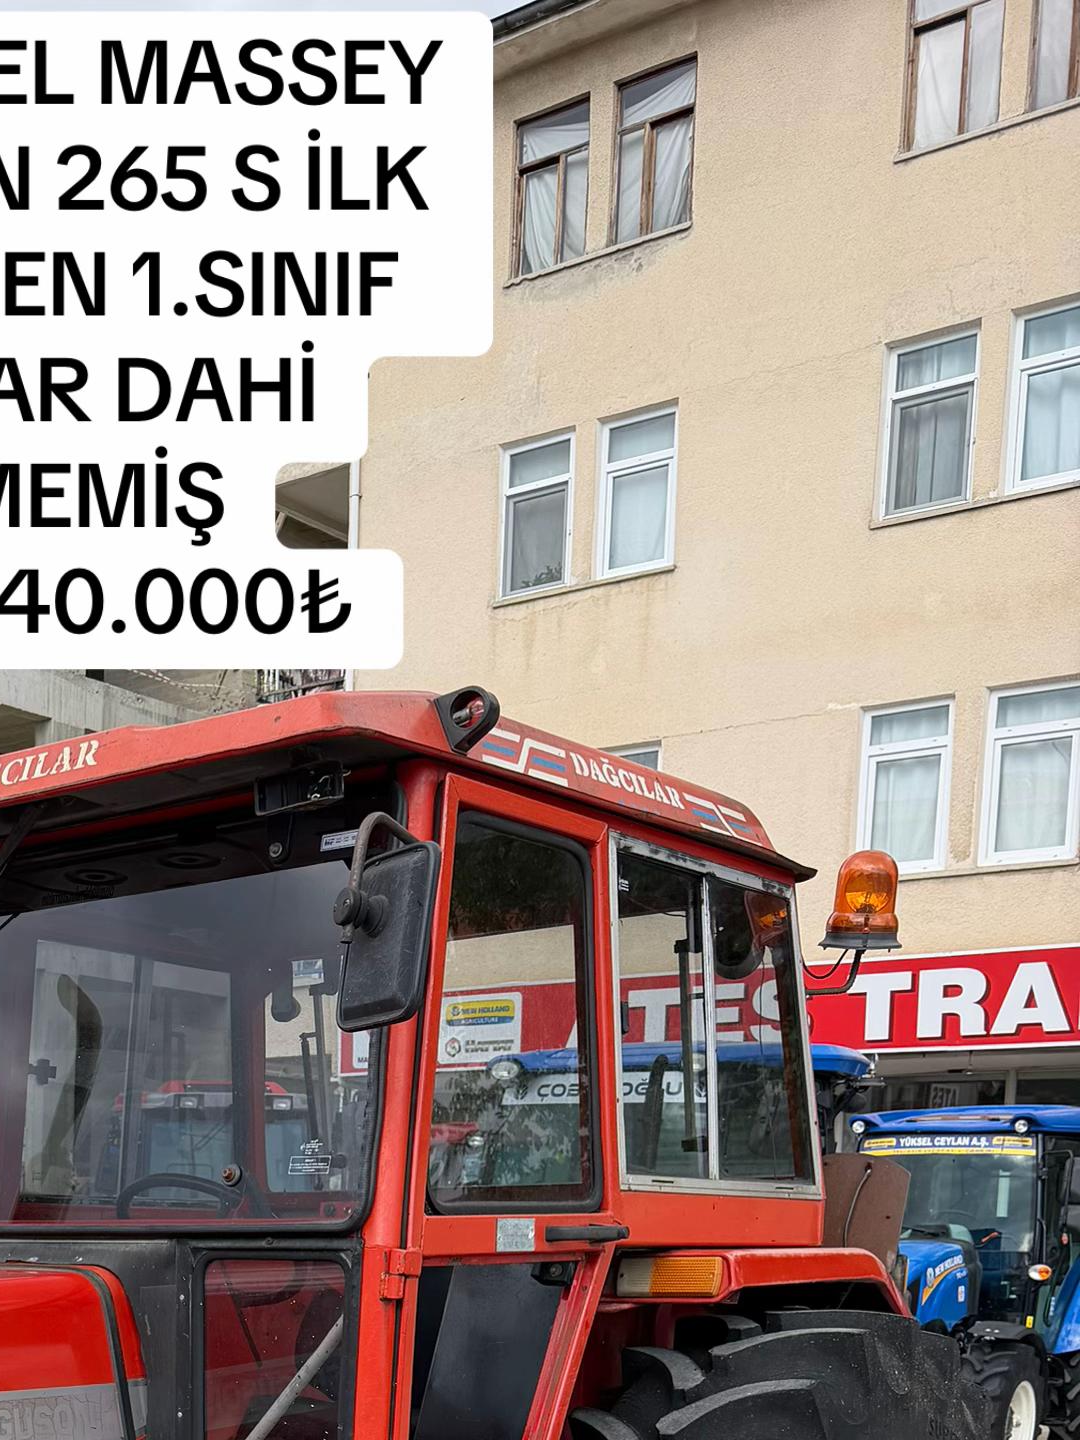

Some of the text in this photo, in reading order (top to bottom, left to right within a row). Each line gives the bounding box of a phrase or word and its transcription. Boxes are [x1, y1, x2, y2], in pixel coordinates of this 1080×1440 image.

[570, 752, 685, 809] DAĞCILAR
[846, 961, 1080, 1042] TRA
[934, 1137, 970, 1147] CEYLAN
